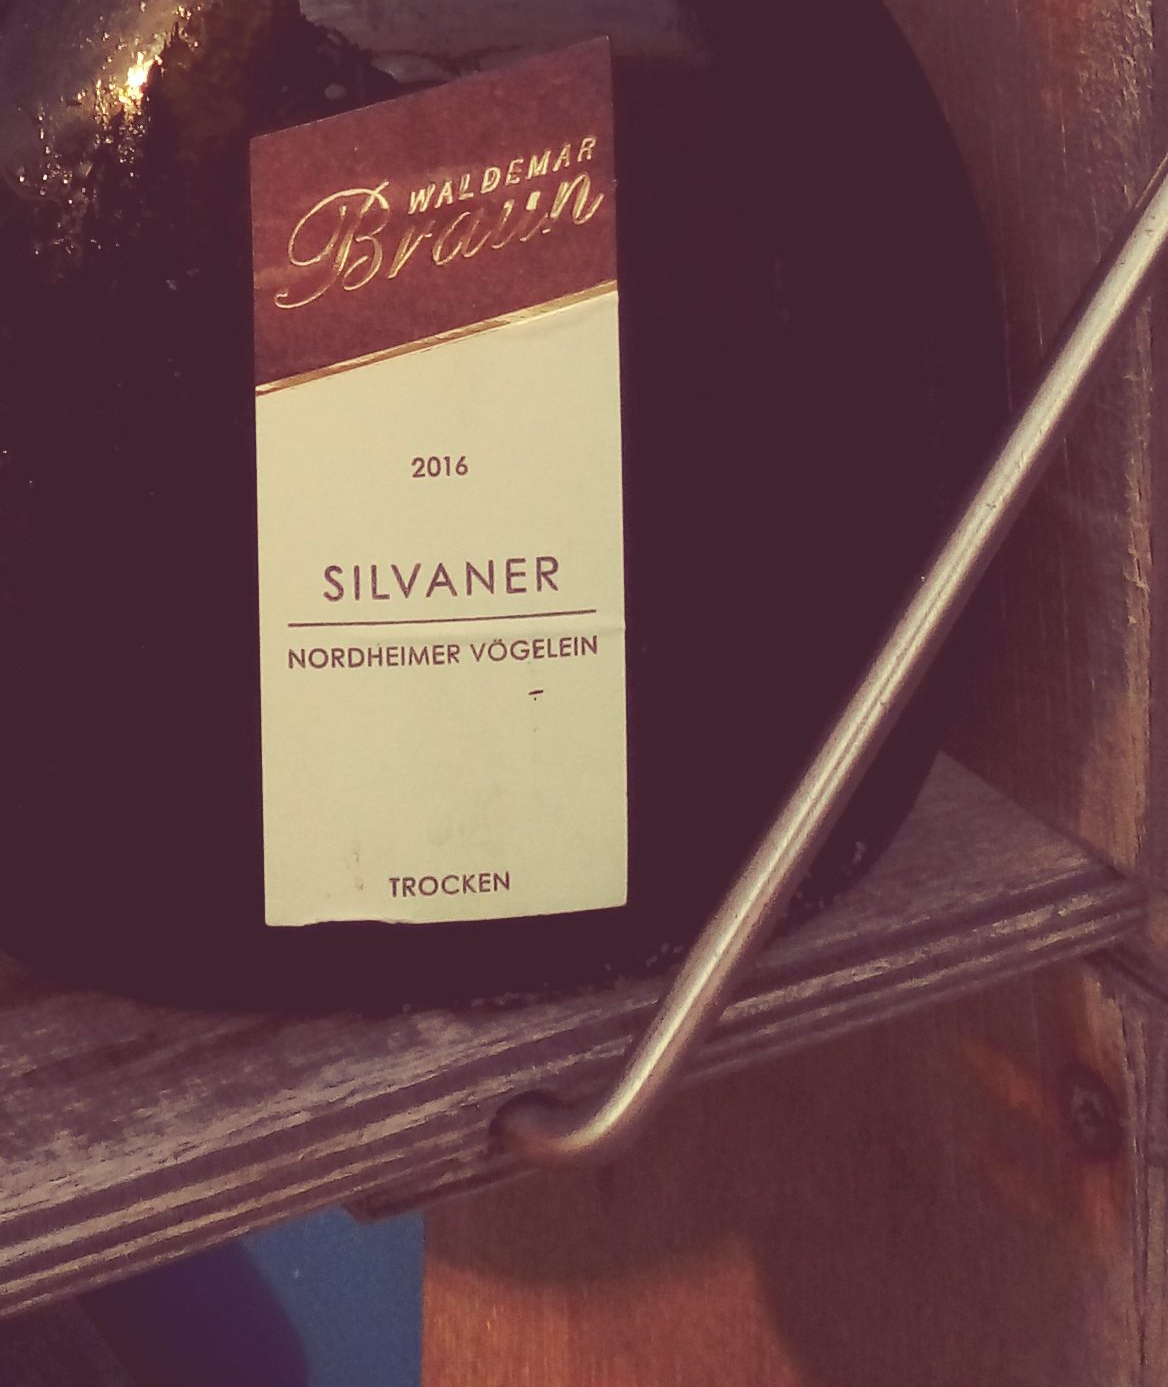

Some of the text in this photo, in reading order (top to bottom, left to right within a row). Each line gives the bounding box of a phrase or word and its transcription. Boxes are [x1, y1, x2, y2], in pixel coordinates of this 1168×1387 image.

[408, 135, 598, 215] WALDEMAR
[274, 171, 605, 309] Braun
[411, 455, 469, 479] 2016
[322, 555, 561, 603] SILVANER
[287, 634, 599, 670] NORDHEIMER VÖGELEIN
[388, 870, 512, 899] TROCKEN
